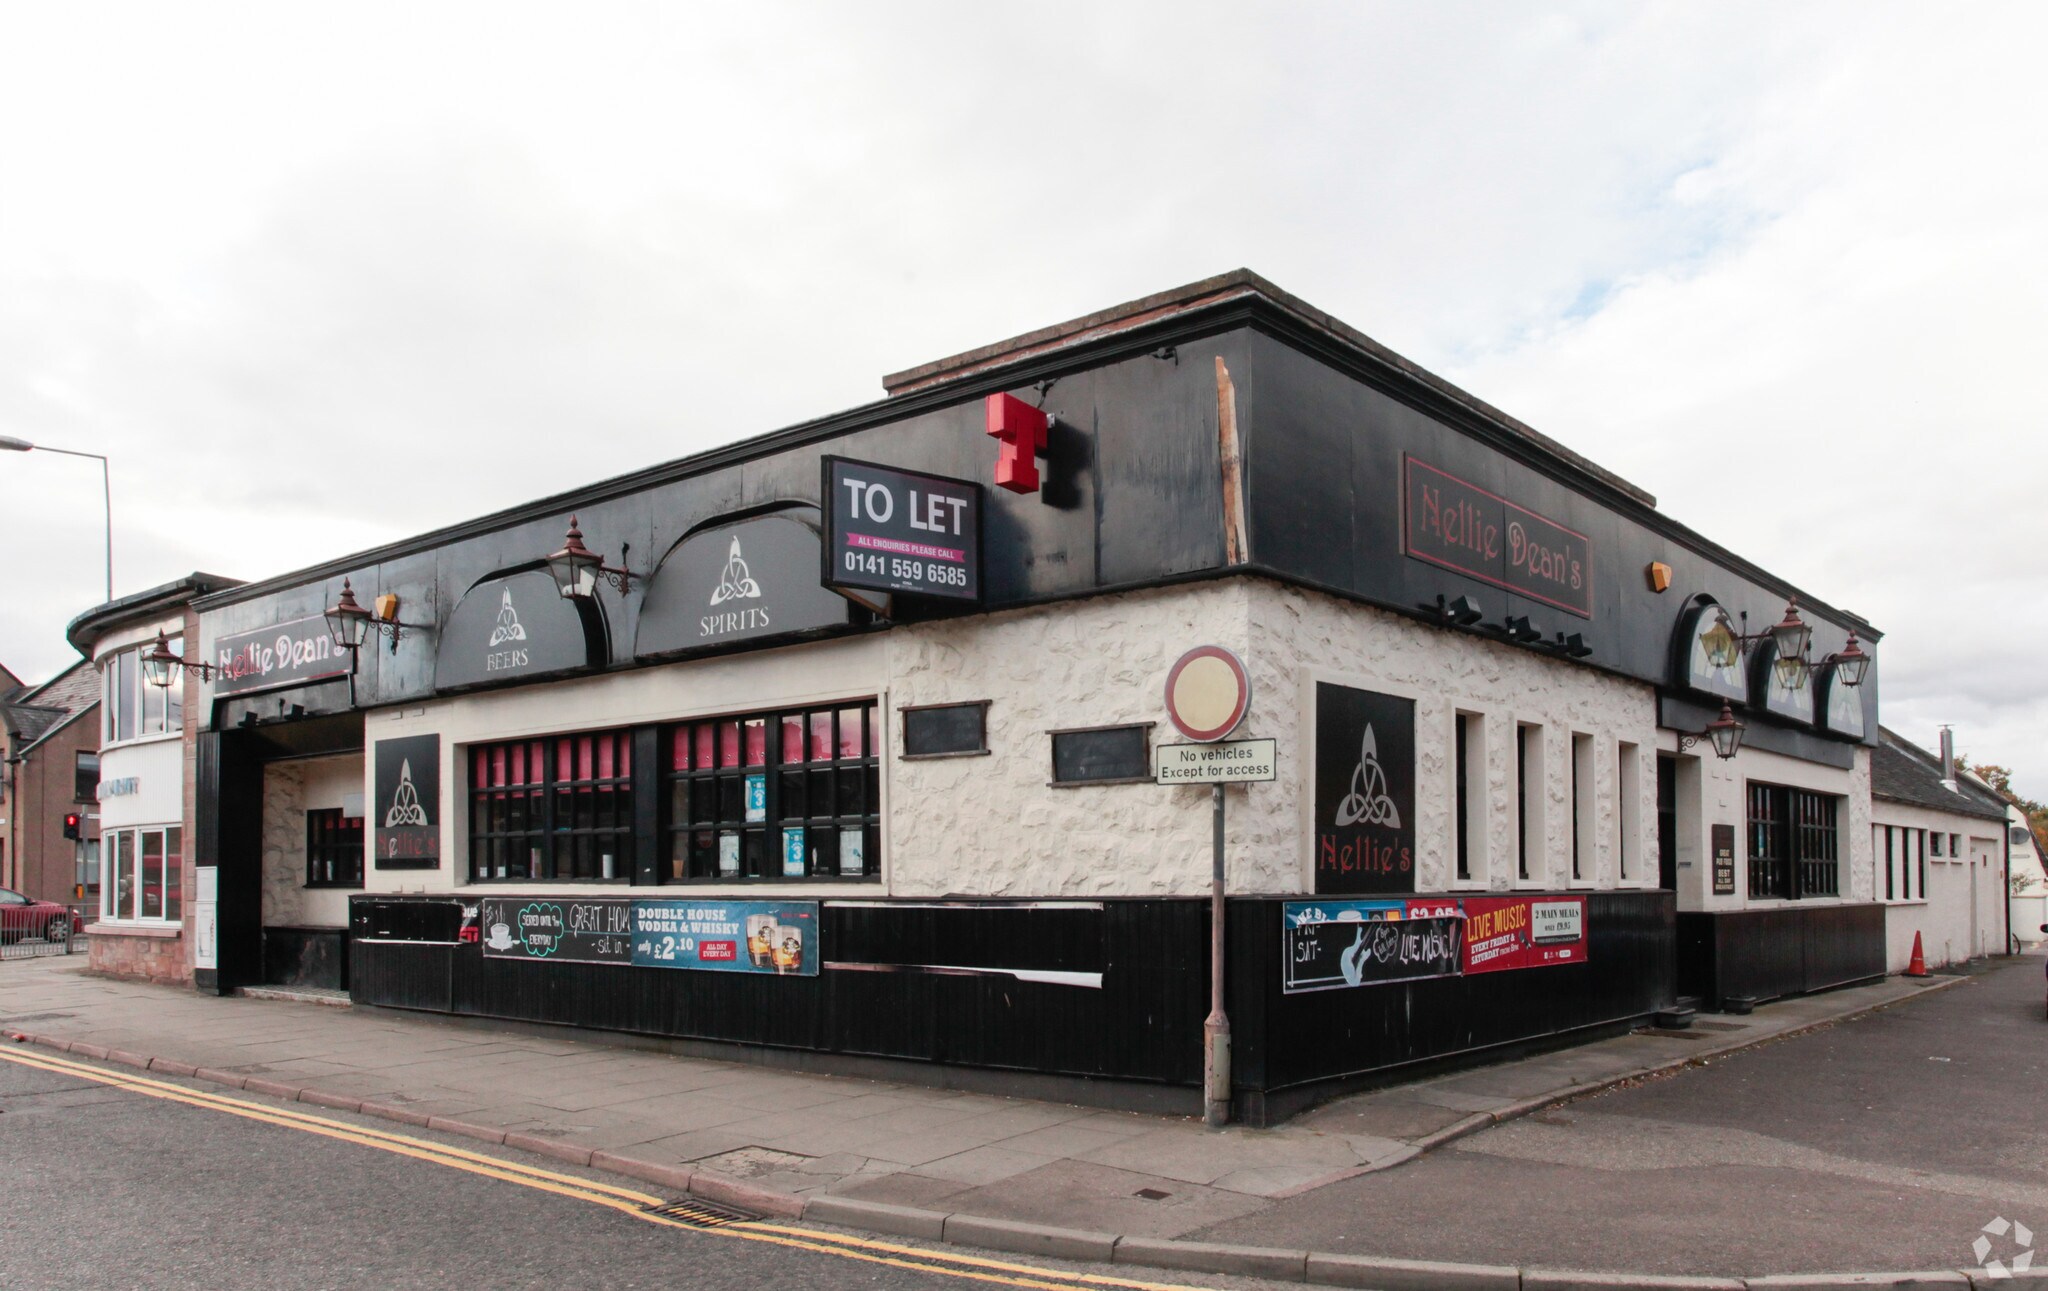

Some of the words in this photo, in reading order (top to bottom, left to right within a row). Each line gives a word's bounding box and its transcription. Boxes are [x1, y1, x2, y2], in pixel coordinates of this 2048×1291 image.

[843, 478, 894, 523] TO
[910, 490, 967, 536] LET
[858, 537, 871, 547] ALL
[873, 539, 909, 552] ENQUIRIES
[911, 545, 936, 556] PLEASE
[938, 549, 954, 559] CALL
[1421, 484, 1499, 561] Nellie
[1509, 521, 1582, 590] Dean's
[845, 552, 885, 576] 0141
[892, 559, 922, 580] 559
[927, 564, 966, 587] 6585
[700, 606, 770, 637] SPIRITS
[218, 642, 273, 681] Nellie
[487, 648, 529, 672] BEERS
[1180, 750, 1196, 762] No
[1200, 748, 1253, 761] vehicles
[1162, 765, 1202, 778] Except
[1207, 765, 1223, 776] for
[1226, 764, 1269, 775] access
[377, 831, 437, 858] Nellie's
[1320, 834, 1410, 875] Nellie's
[569, 904, 602, 938] GREAT
[638, 908, 684, 920] DOUBLE
[687, 909, 726, 921] HOUSE
[1467, 913, 1491, 942] LIVE
[1494, 904, 1526, 934] MUSIC
[1535, 910, 1539, 919] 2
[1541, 908, 1557, 919] MAIN
[1559, 907, 1579, 918] MEALS
[638, 921, 678, 933] VODKA
[680, 922, 689, 933] &
[690, 922, 739, 935] WHISKY
[597, 936, 611, 954] sit
[614, 939, 622, 954] in
[638, 939, 651, 956] only
[654, 936, 694, 960] £2.10
[703, 950, 719, 958] EVERY
[706, 943, 717, 951] ALL
[1400, 934, 1420, 964] LIVE
[1471, 941, 1489, 954] EVERY
[1490, 934, 1510, 948] FRIDAY
[1471, 948, 1499, 965] SATURDAY
